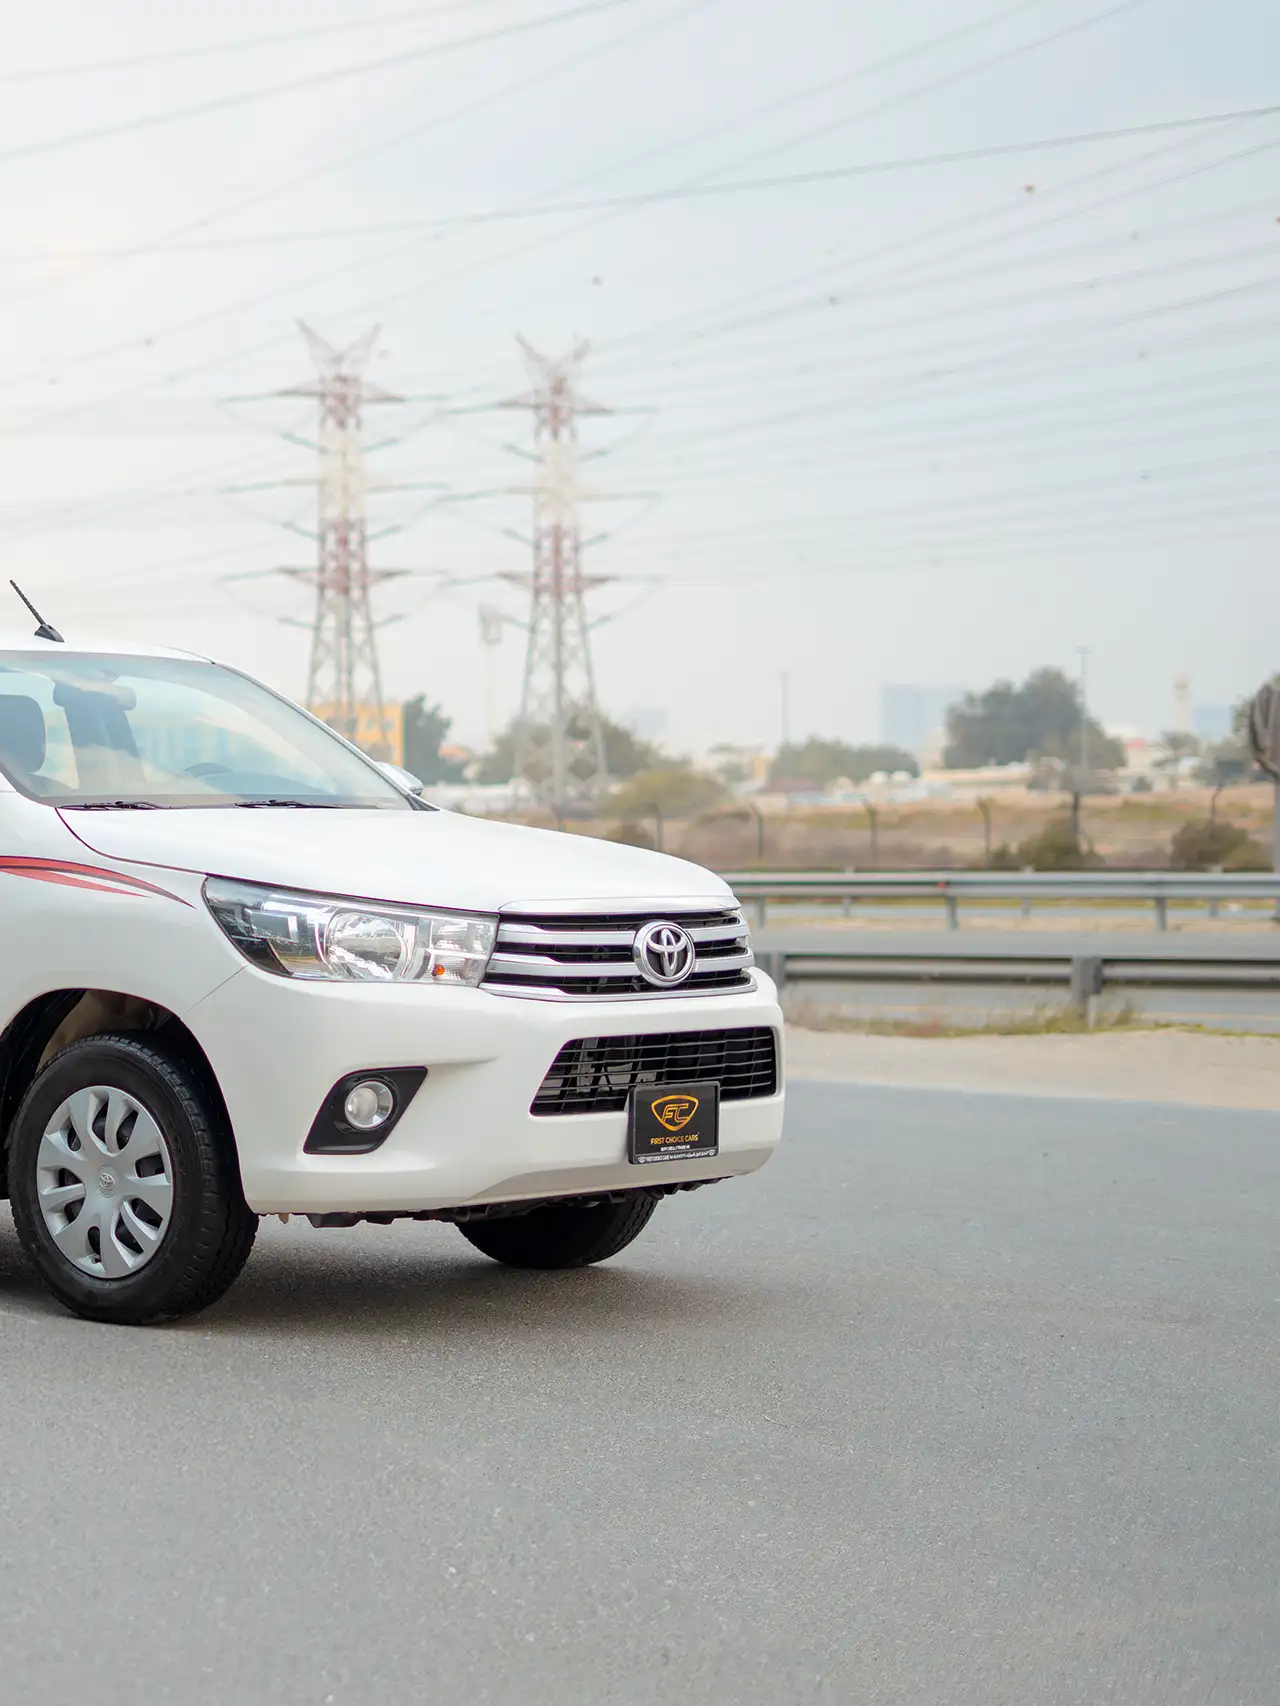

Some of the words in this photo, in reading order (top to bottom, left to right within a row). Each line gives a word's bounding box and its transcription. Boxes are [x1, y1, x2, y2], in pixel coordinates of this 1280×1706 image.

[650, 1136, 665, 1145] FIRST
[665, 1135, 684, 1144] CHOICE
[685, 1134, 698, 1142] CARS
